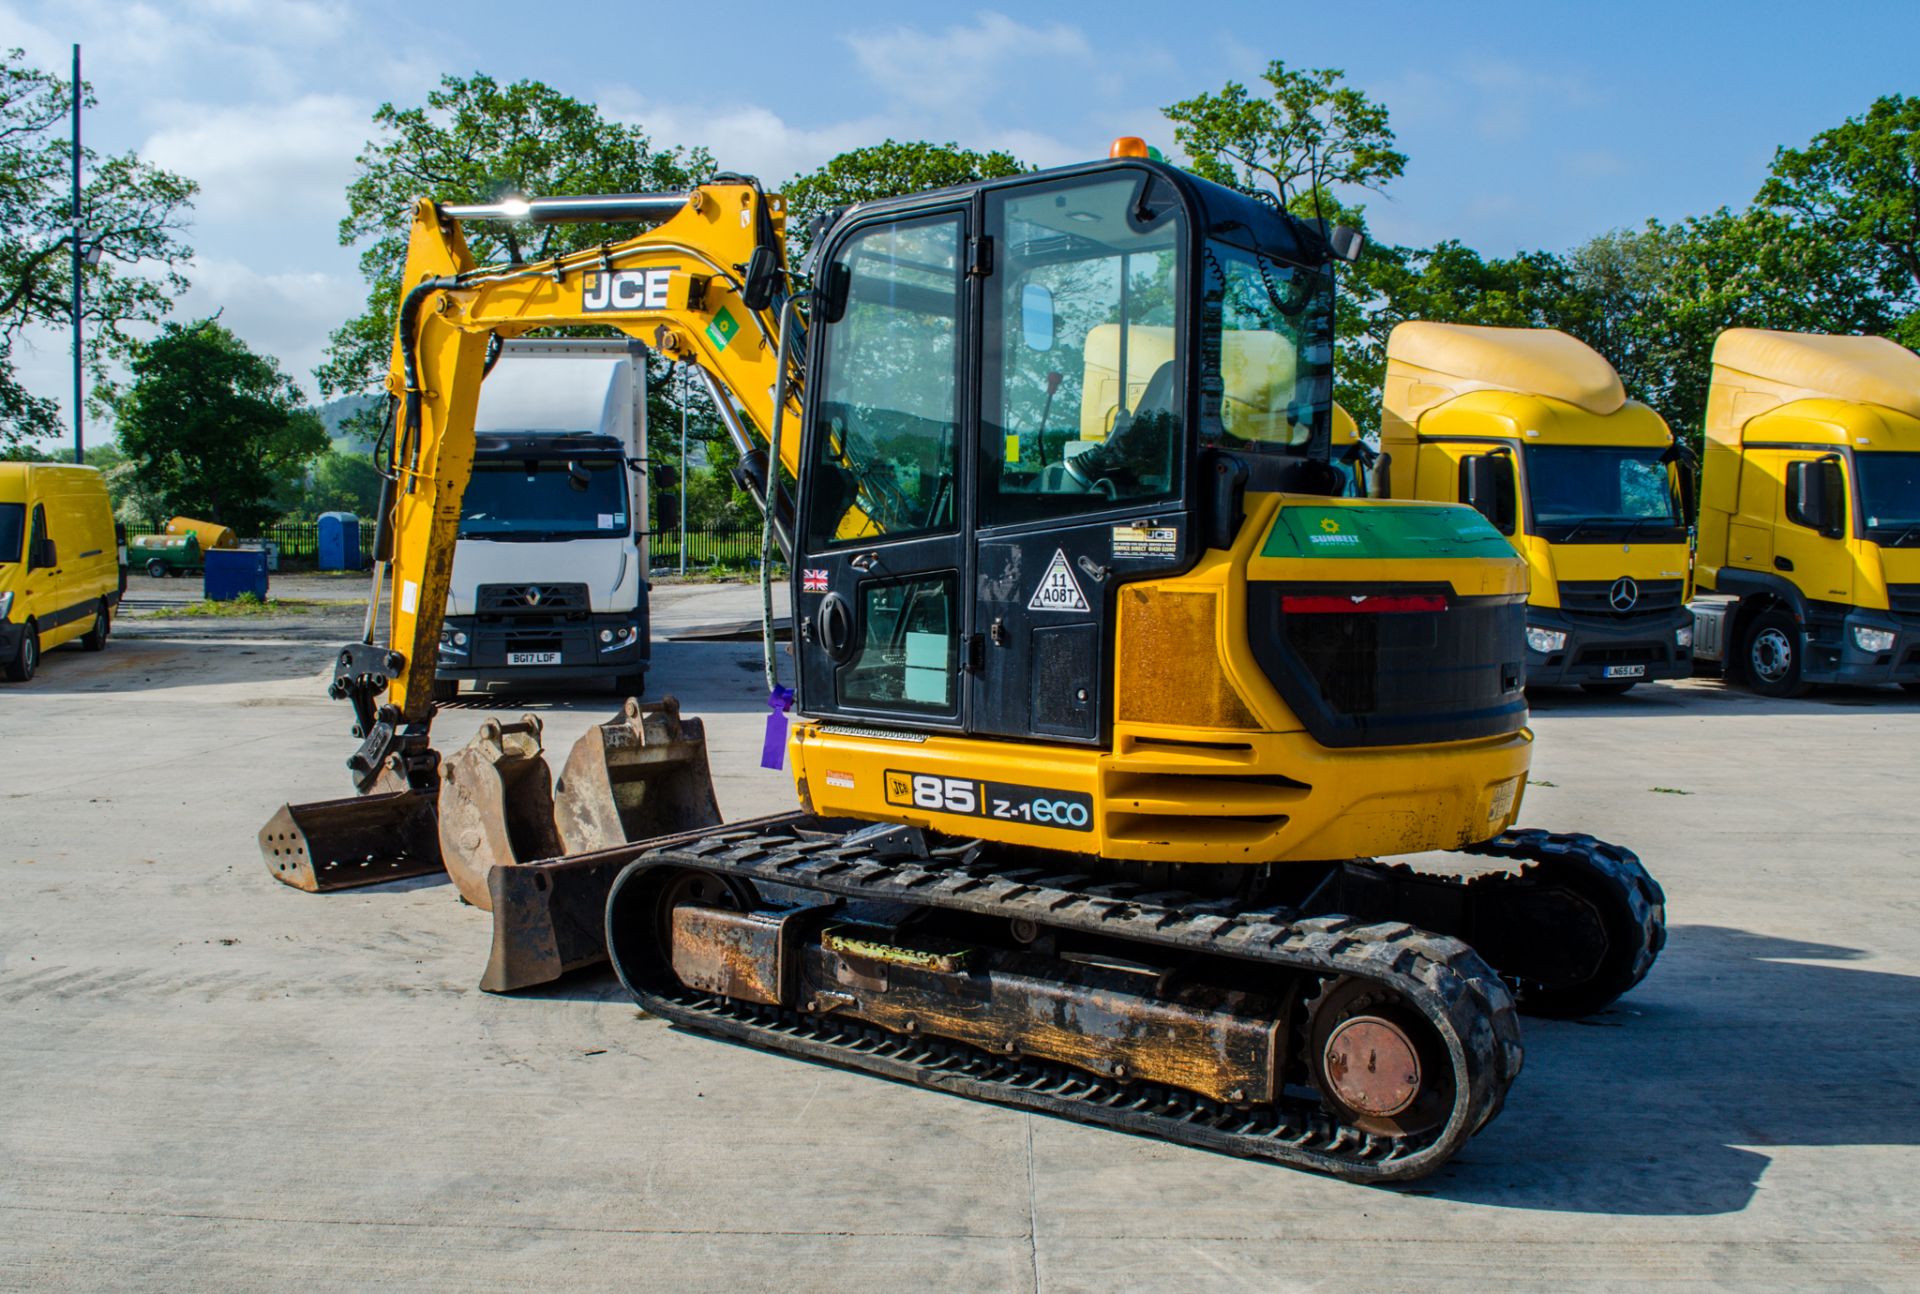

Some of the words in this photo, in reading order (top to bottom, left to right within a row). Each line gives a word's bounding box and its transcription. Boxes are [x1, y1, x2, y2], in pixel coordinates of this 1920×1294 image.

[1146, 530, 1173, 539] JCB
[1309, 534, 1360, 543] SUNBELT
[1051, 573, 1067, 588] 11
[1043, 588, 1075, 603] A08T
[513, 653, 534, 663] BG17
[536, 653, 555, 663] LDF
[893, 781, 909, 795] JCB
[912, 775, 976, 813] 85
